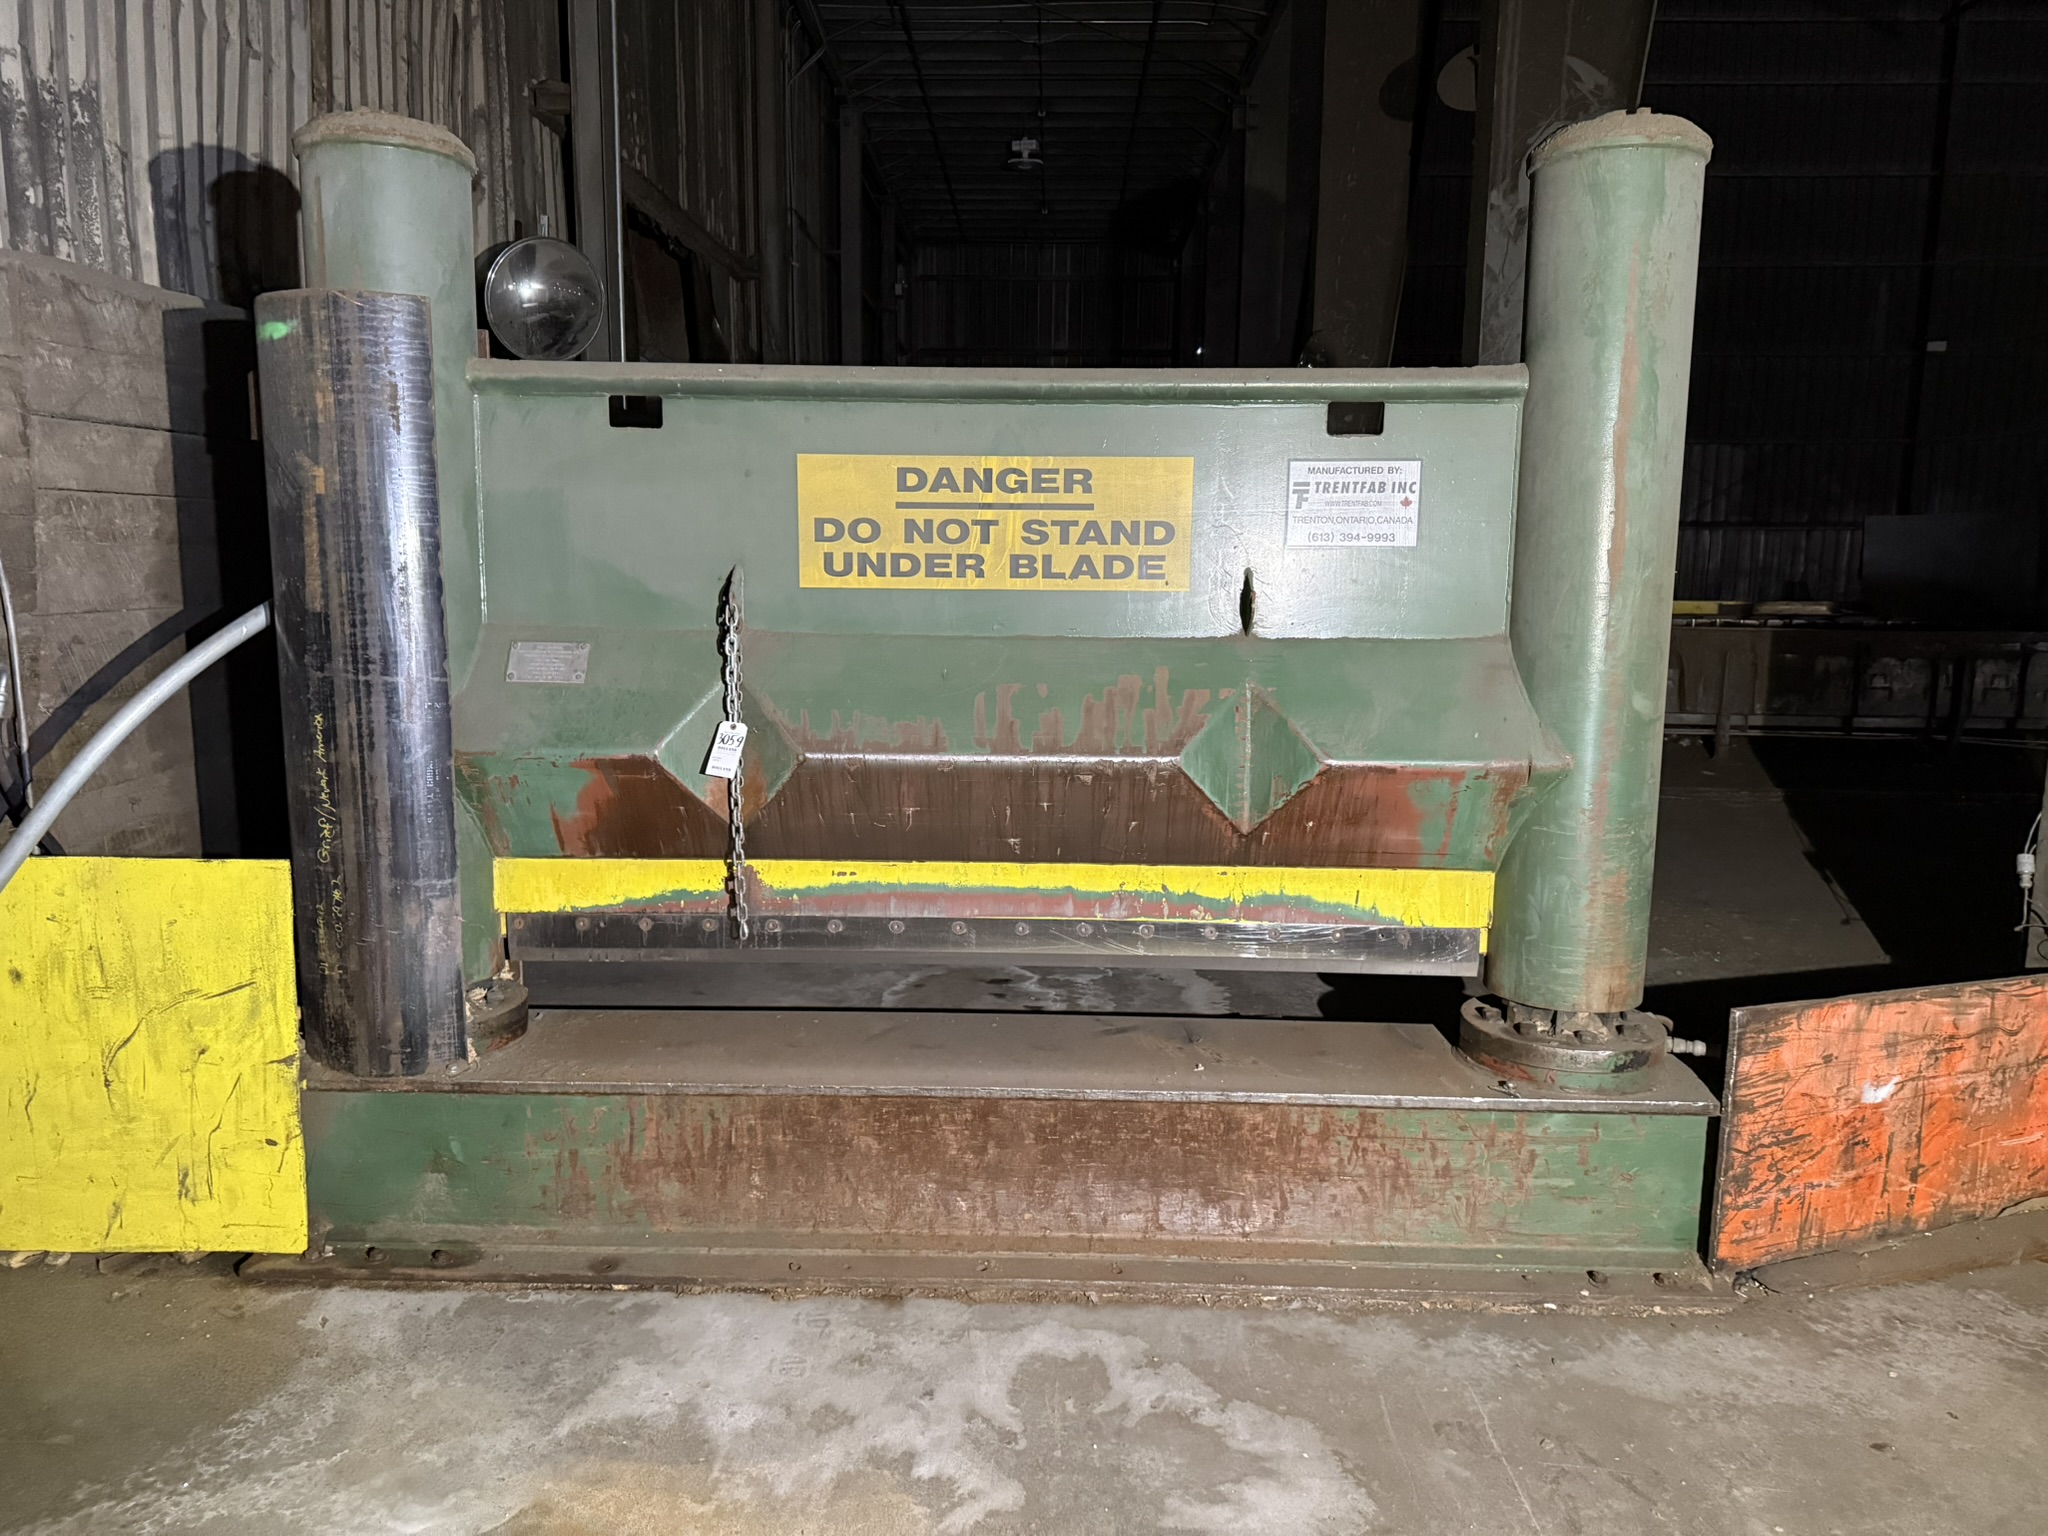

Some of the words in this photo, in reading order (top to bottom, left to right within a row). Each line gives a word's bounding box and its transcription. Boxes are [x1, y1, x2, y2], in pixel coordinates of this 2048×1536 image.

[1307, 467, 1384, 475] MANUFACTURED
[1387, 467, 1403, 475] BY:
[896, 466, 1094, 494] DANGER
[1314, 481, 1387, 494] TRENTFAB
[1390, 481, 1417, 494] INC
[813, 517, 882, 544] DO
[903, 518, 1000, 545] NOT
[1020, 519, 1176, 546] STAND
[1307, 532, 1335, 543] (613)
[1339, 533, 1396, 543] 394-9993
[822, 552, 986, 579] UNDER
[1008, 553, 1167, 580] BLADE
[717, 732, 745, 748] 3059
